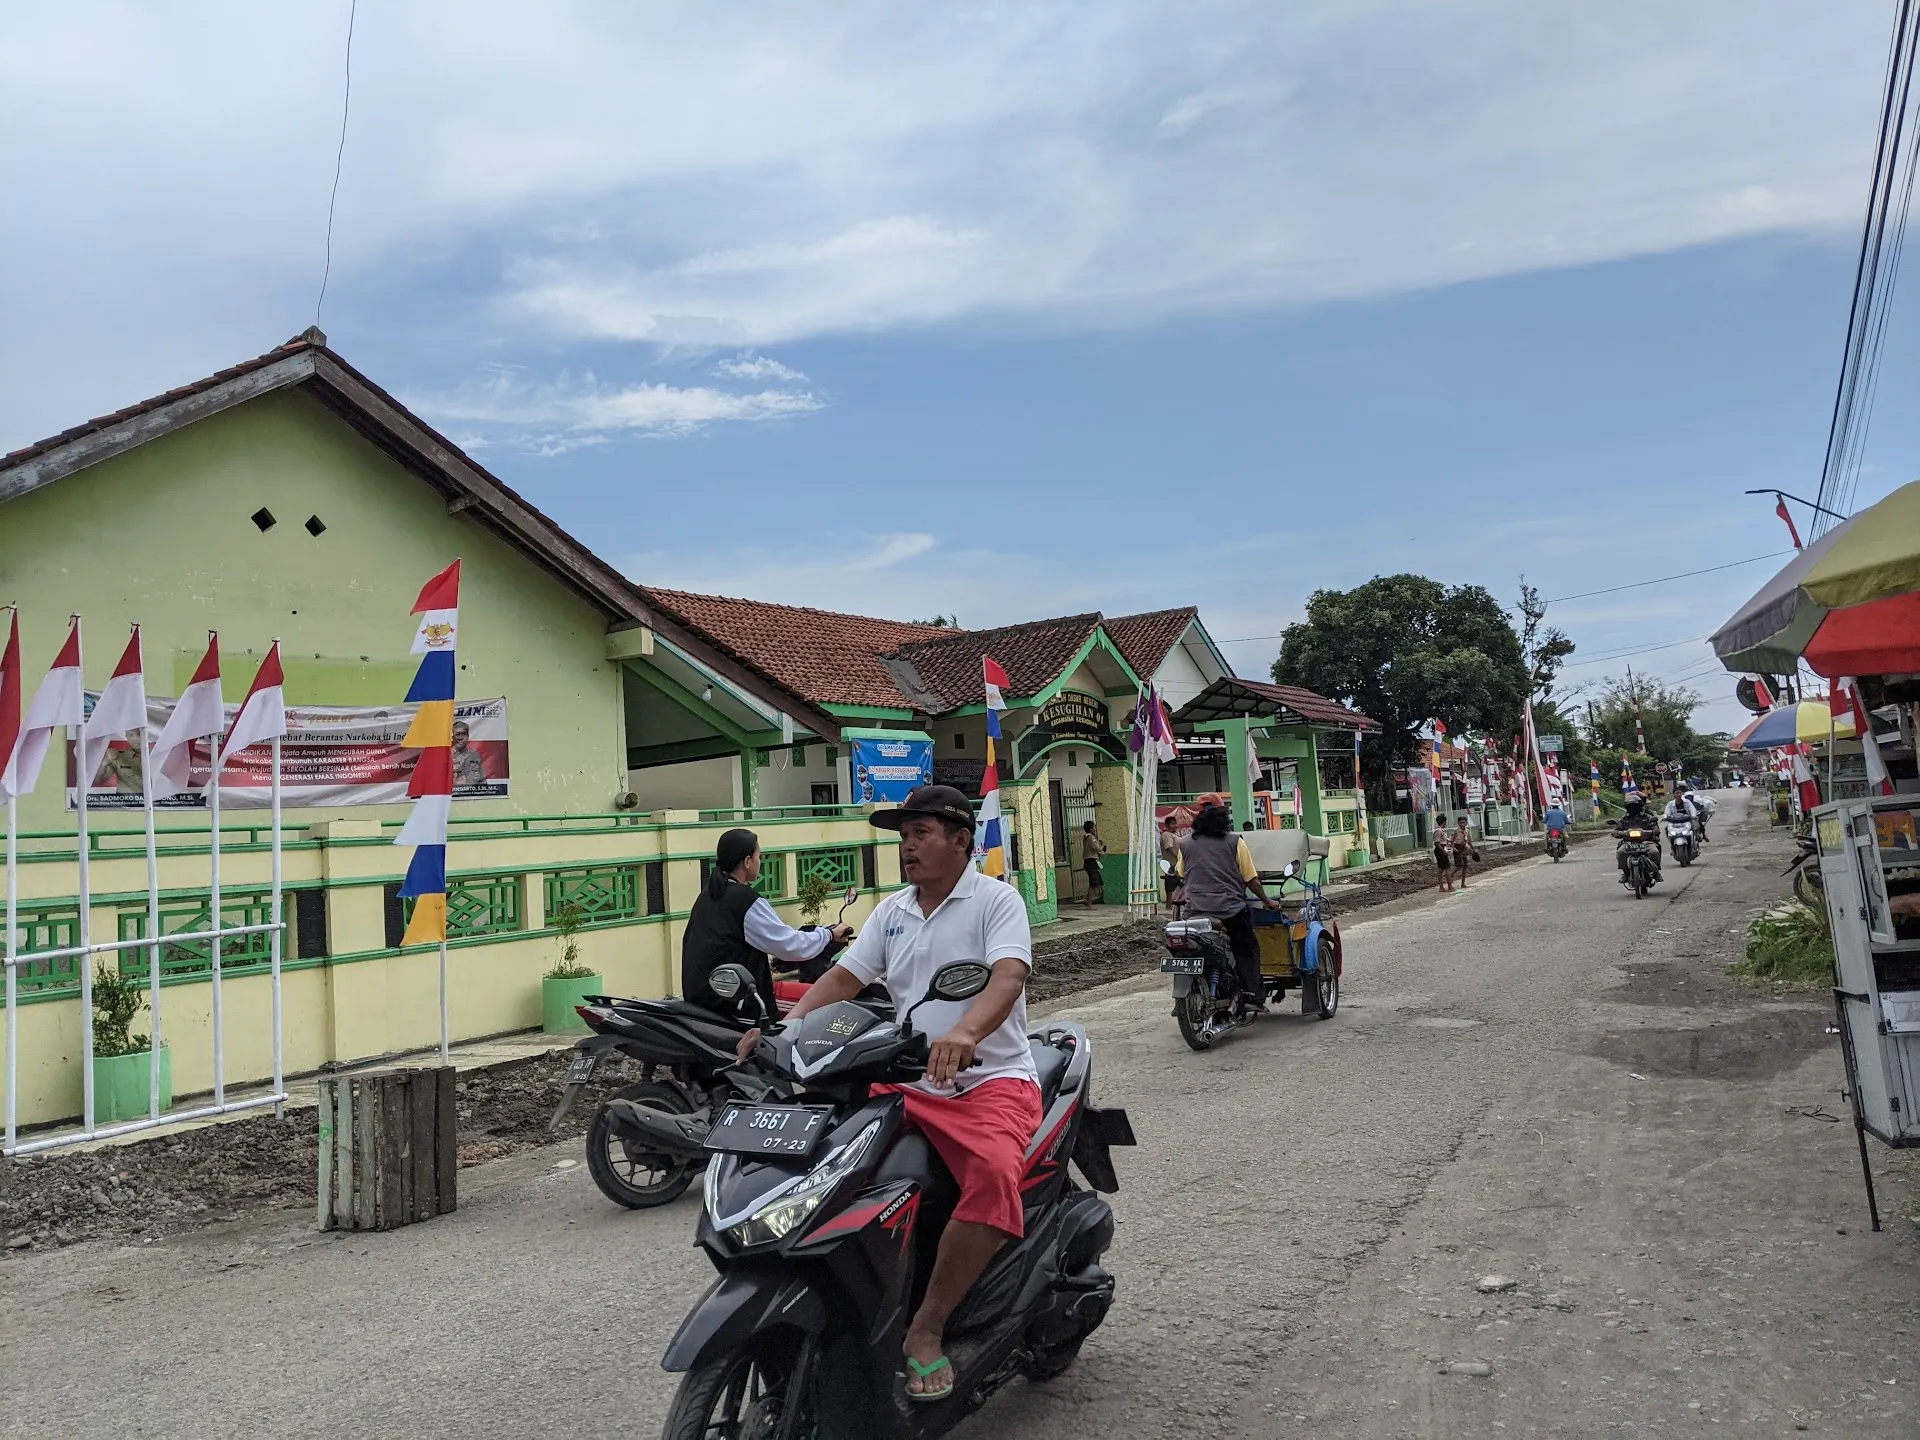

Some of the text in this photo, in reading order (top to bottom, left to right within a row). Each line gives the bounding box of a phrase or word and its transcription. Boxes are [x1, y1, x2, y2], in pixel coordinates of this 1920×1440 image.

[1068, 694, 1082, 703] DASAR
[1083, 696, 1099, 709] NEGERI
[1043, 704, 1104, 725] KESUGIHAN 01
[1051, 716, 1098, 729] KECAMATAN KESUGIHAN
[280, 733, 301, 741] ebat
[304, 733, 343, 741] Berantas
[345, 733, 381, 741] Narkoba
[383, 732, 391, 741] di
[301, 749, 326, 757] Ampuh
[327, 748, 365, 756] MENGUBAH
[249, 765, 285, 774] Wujudn
[287, 765, 317, 773] SEKOLAH
[335, 772, 372, 780] INDONESIA
[1172, 959, 1189, 967] 5762
[723, 1109, 821, 1132] R 3661 F
[879, 1191, 912, 1223] HONDA
